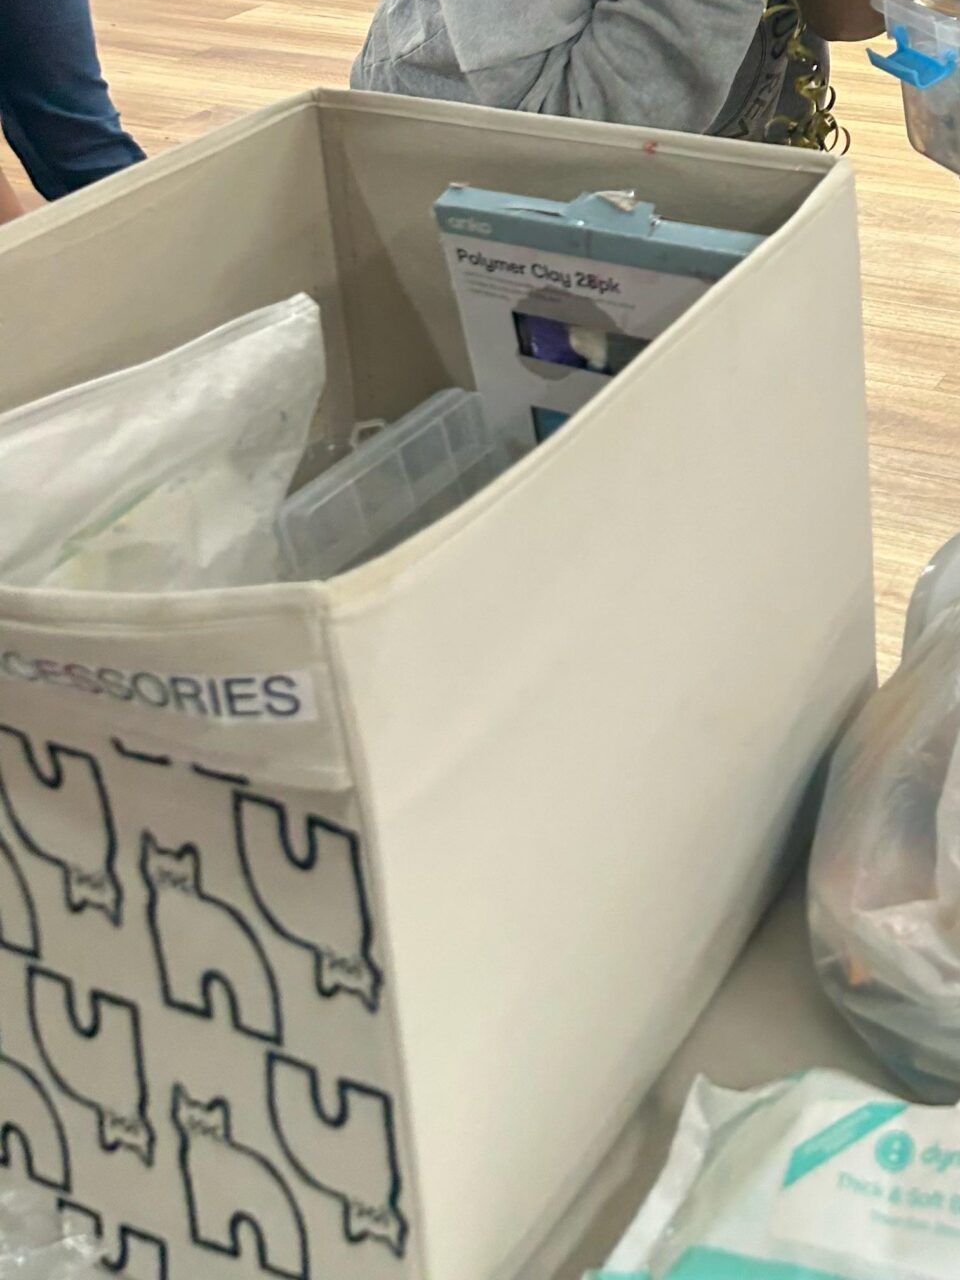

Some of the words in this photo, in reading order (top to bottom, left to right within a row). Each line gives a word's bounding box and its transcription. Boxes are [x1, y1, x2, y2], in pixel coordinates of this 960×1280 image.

[456, 248, 526, 275] Polymer
[531, 263, 572, 288] Clay
[575, 271, 622, 294] 28pk
